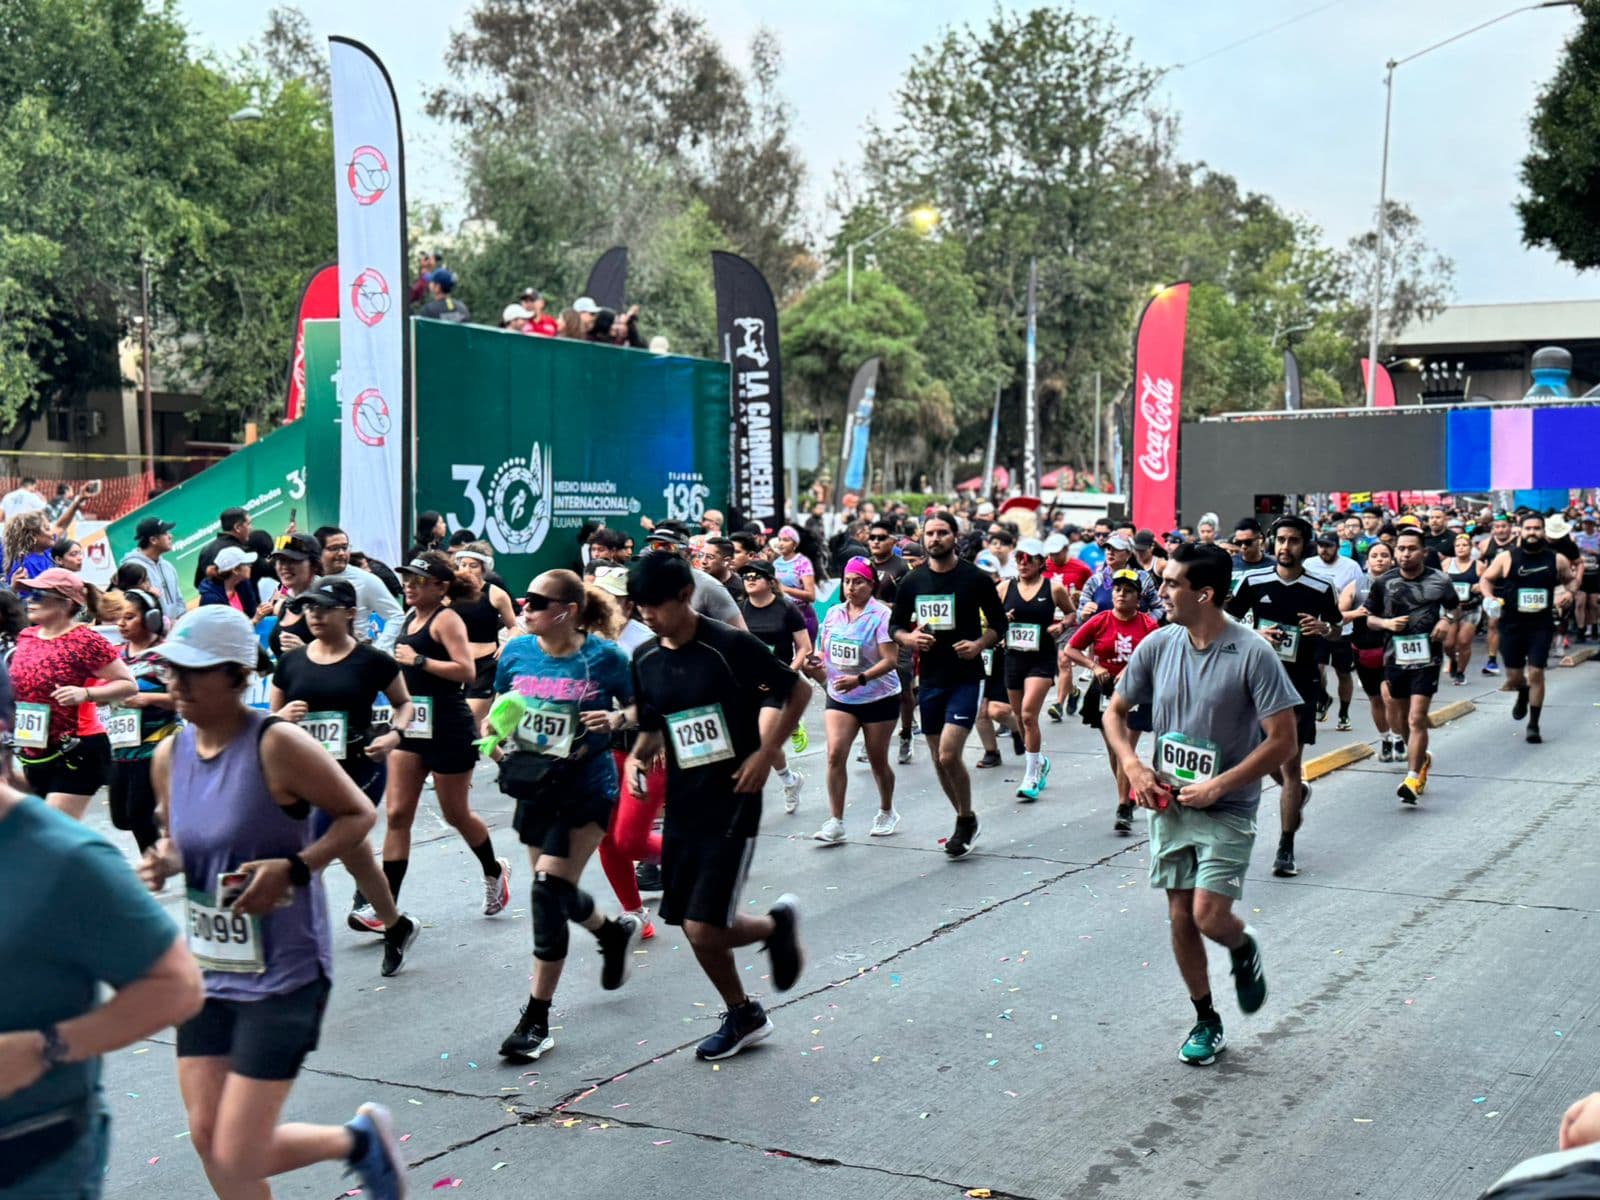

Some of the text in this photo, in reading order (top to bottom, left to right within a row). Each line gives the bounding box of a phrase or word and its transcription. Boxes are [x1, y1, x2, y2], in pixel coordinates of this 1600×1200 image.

[739, 372, 751, 521] MEAT MARKET
[746, 371, 775, 520] LA CARNICERIA
[553, 480, 616, 494] MEDIO MARATÓN
[553, 496, 629, 510] INTERNACIONAL
[552, 517, 583, 529] TIJUANA
[920, 603, 949, 617] 6192
[1011, 630, 1034, 641] 1322
[832, 643, 857, 659] 5561
[1402, 641, 1421, 654] 841
[523, 711, 567, 737] 2857
[676, 719, 718, 747] 1288
[1164, 743, 1213, 775] 6086
